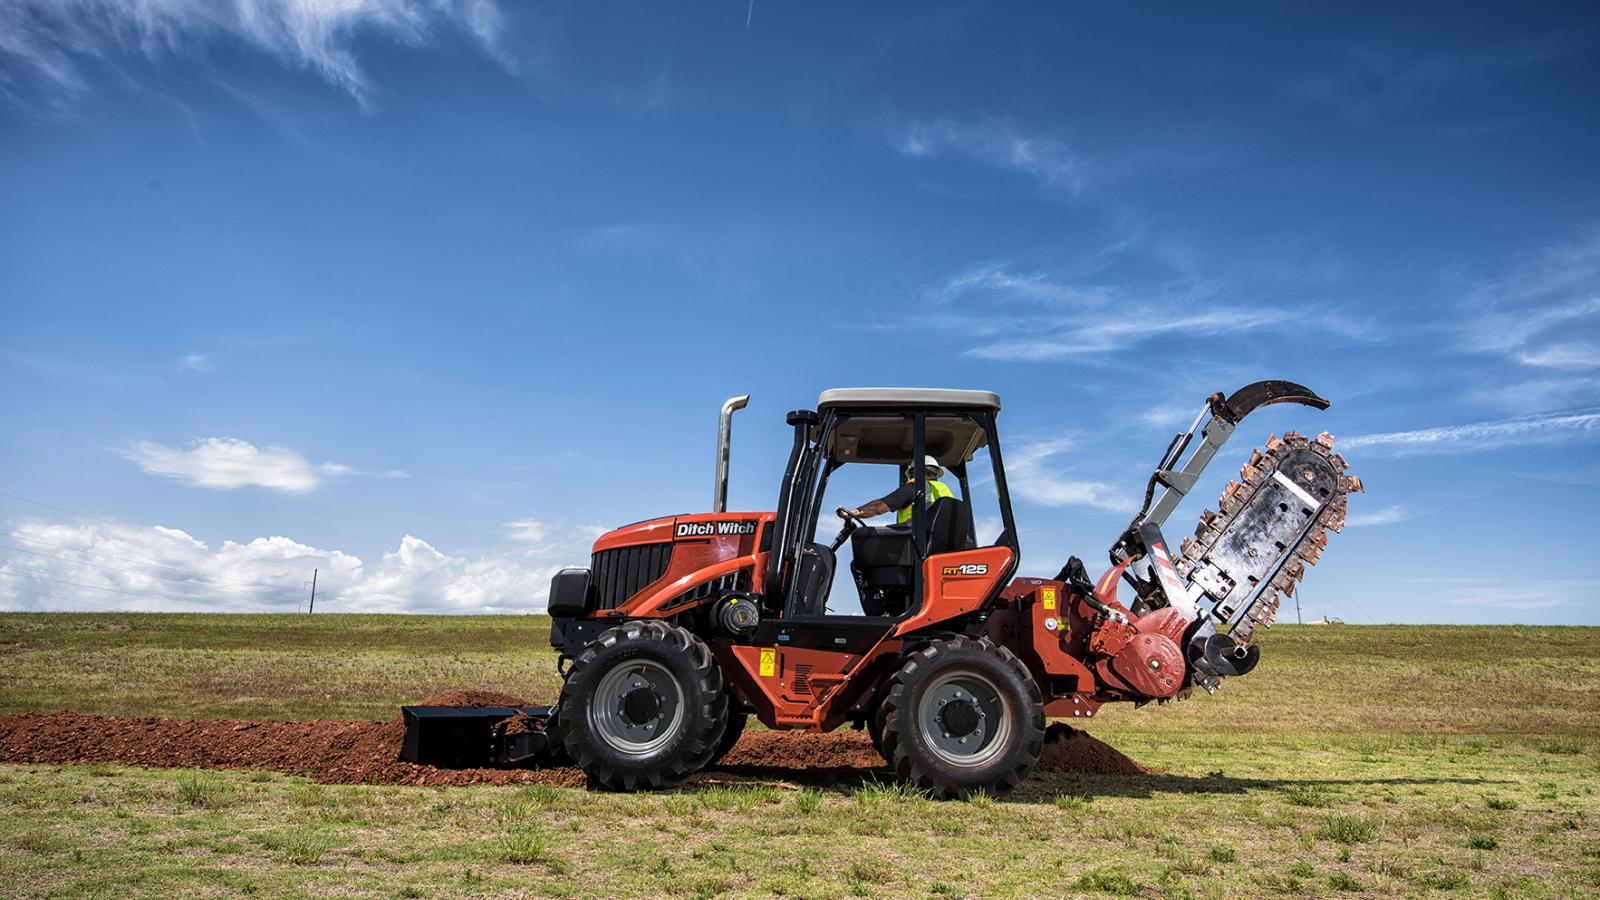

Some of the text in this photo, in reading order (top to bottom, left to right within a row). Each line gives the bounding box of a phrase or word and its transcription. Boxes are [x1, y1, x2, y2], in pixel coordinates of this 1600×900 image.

[677, 521, 755, 536] Ditch Witch
[943, 564, 987, 575] RT125
